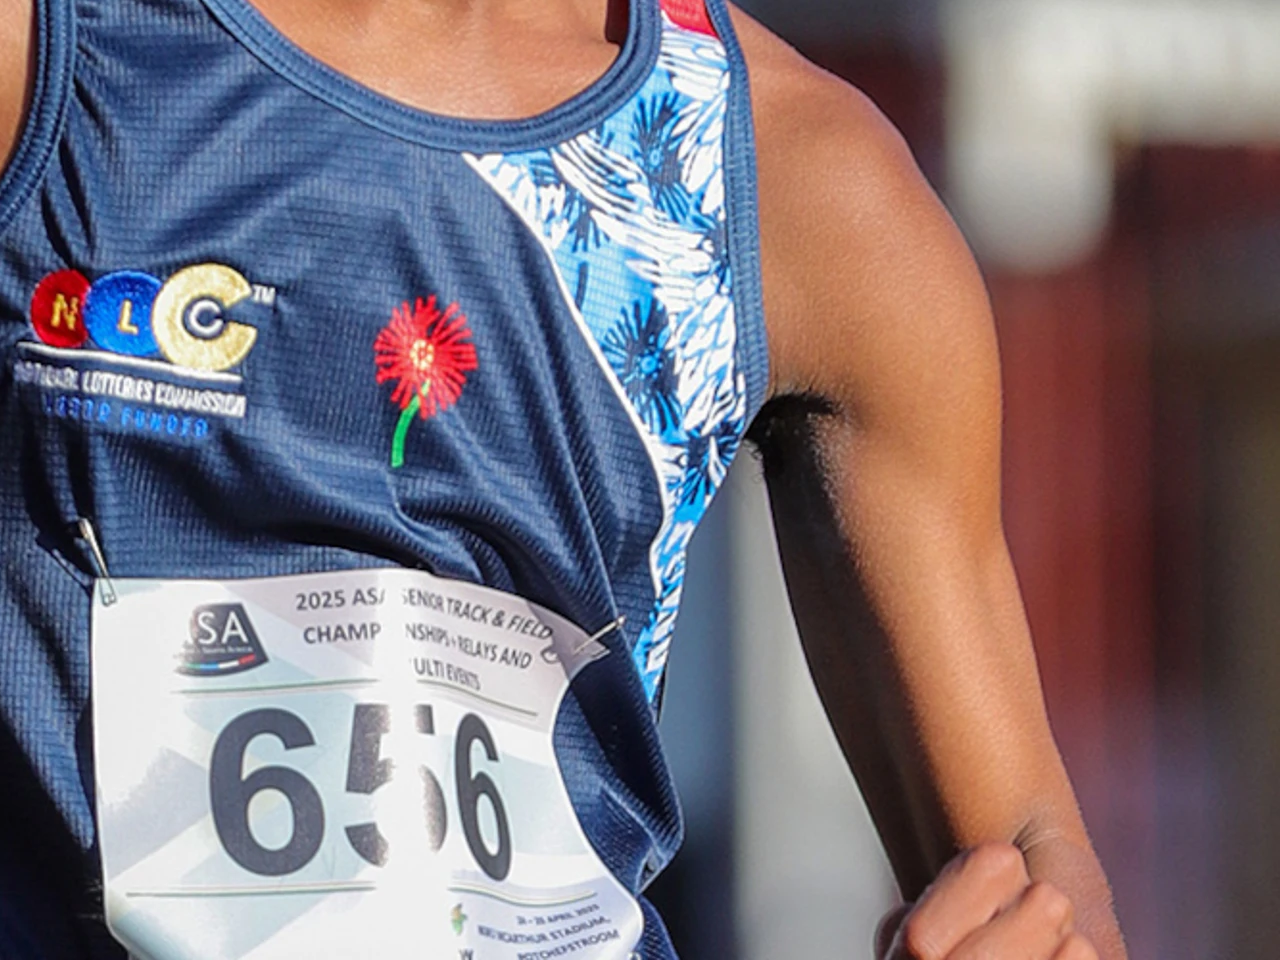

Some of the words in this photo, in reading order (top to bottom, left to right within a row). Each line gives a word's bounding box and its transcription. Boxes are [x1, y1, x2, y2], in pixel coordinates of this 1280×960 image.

[253, 285, 276, 305] TM
[82, 370, 154, 402] LOTTERIES
[154, 382, 247, 418] COMMISSION
[296, 589, 346, 611] 2025
[447, 597, 493, 624] TRACK
[492, 610, 507, 628] &
[506, 615, 554, 640] FIELD
[409, 657, 445, 678] ULTI
[458, 634, 498, 661] RELAYS
[499, 646, 532, 669] AND
[208, 704, 512, 882] 656
